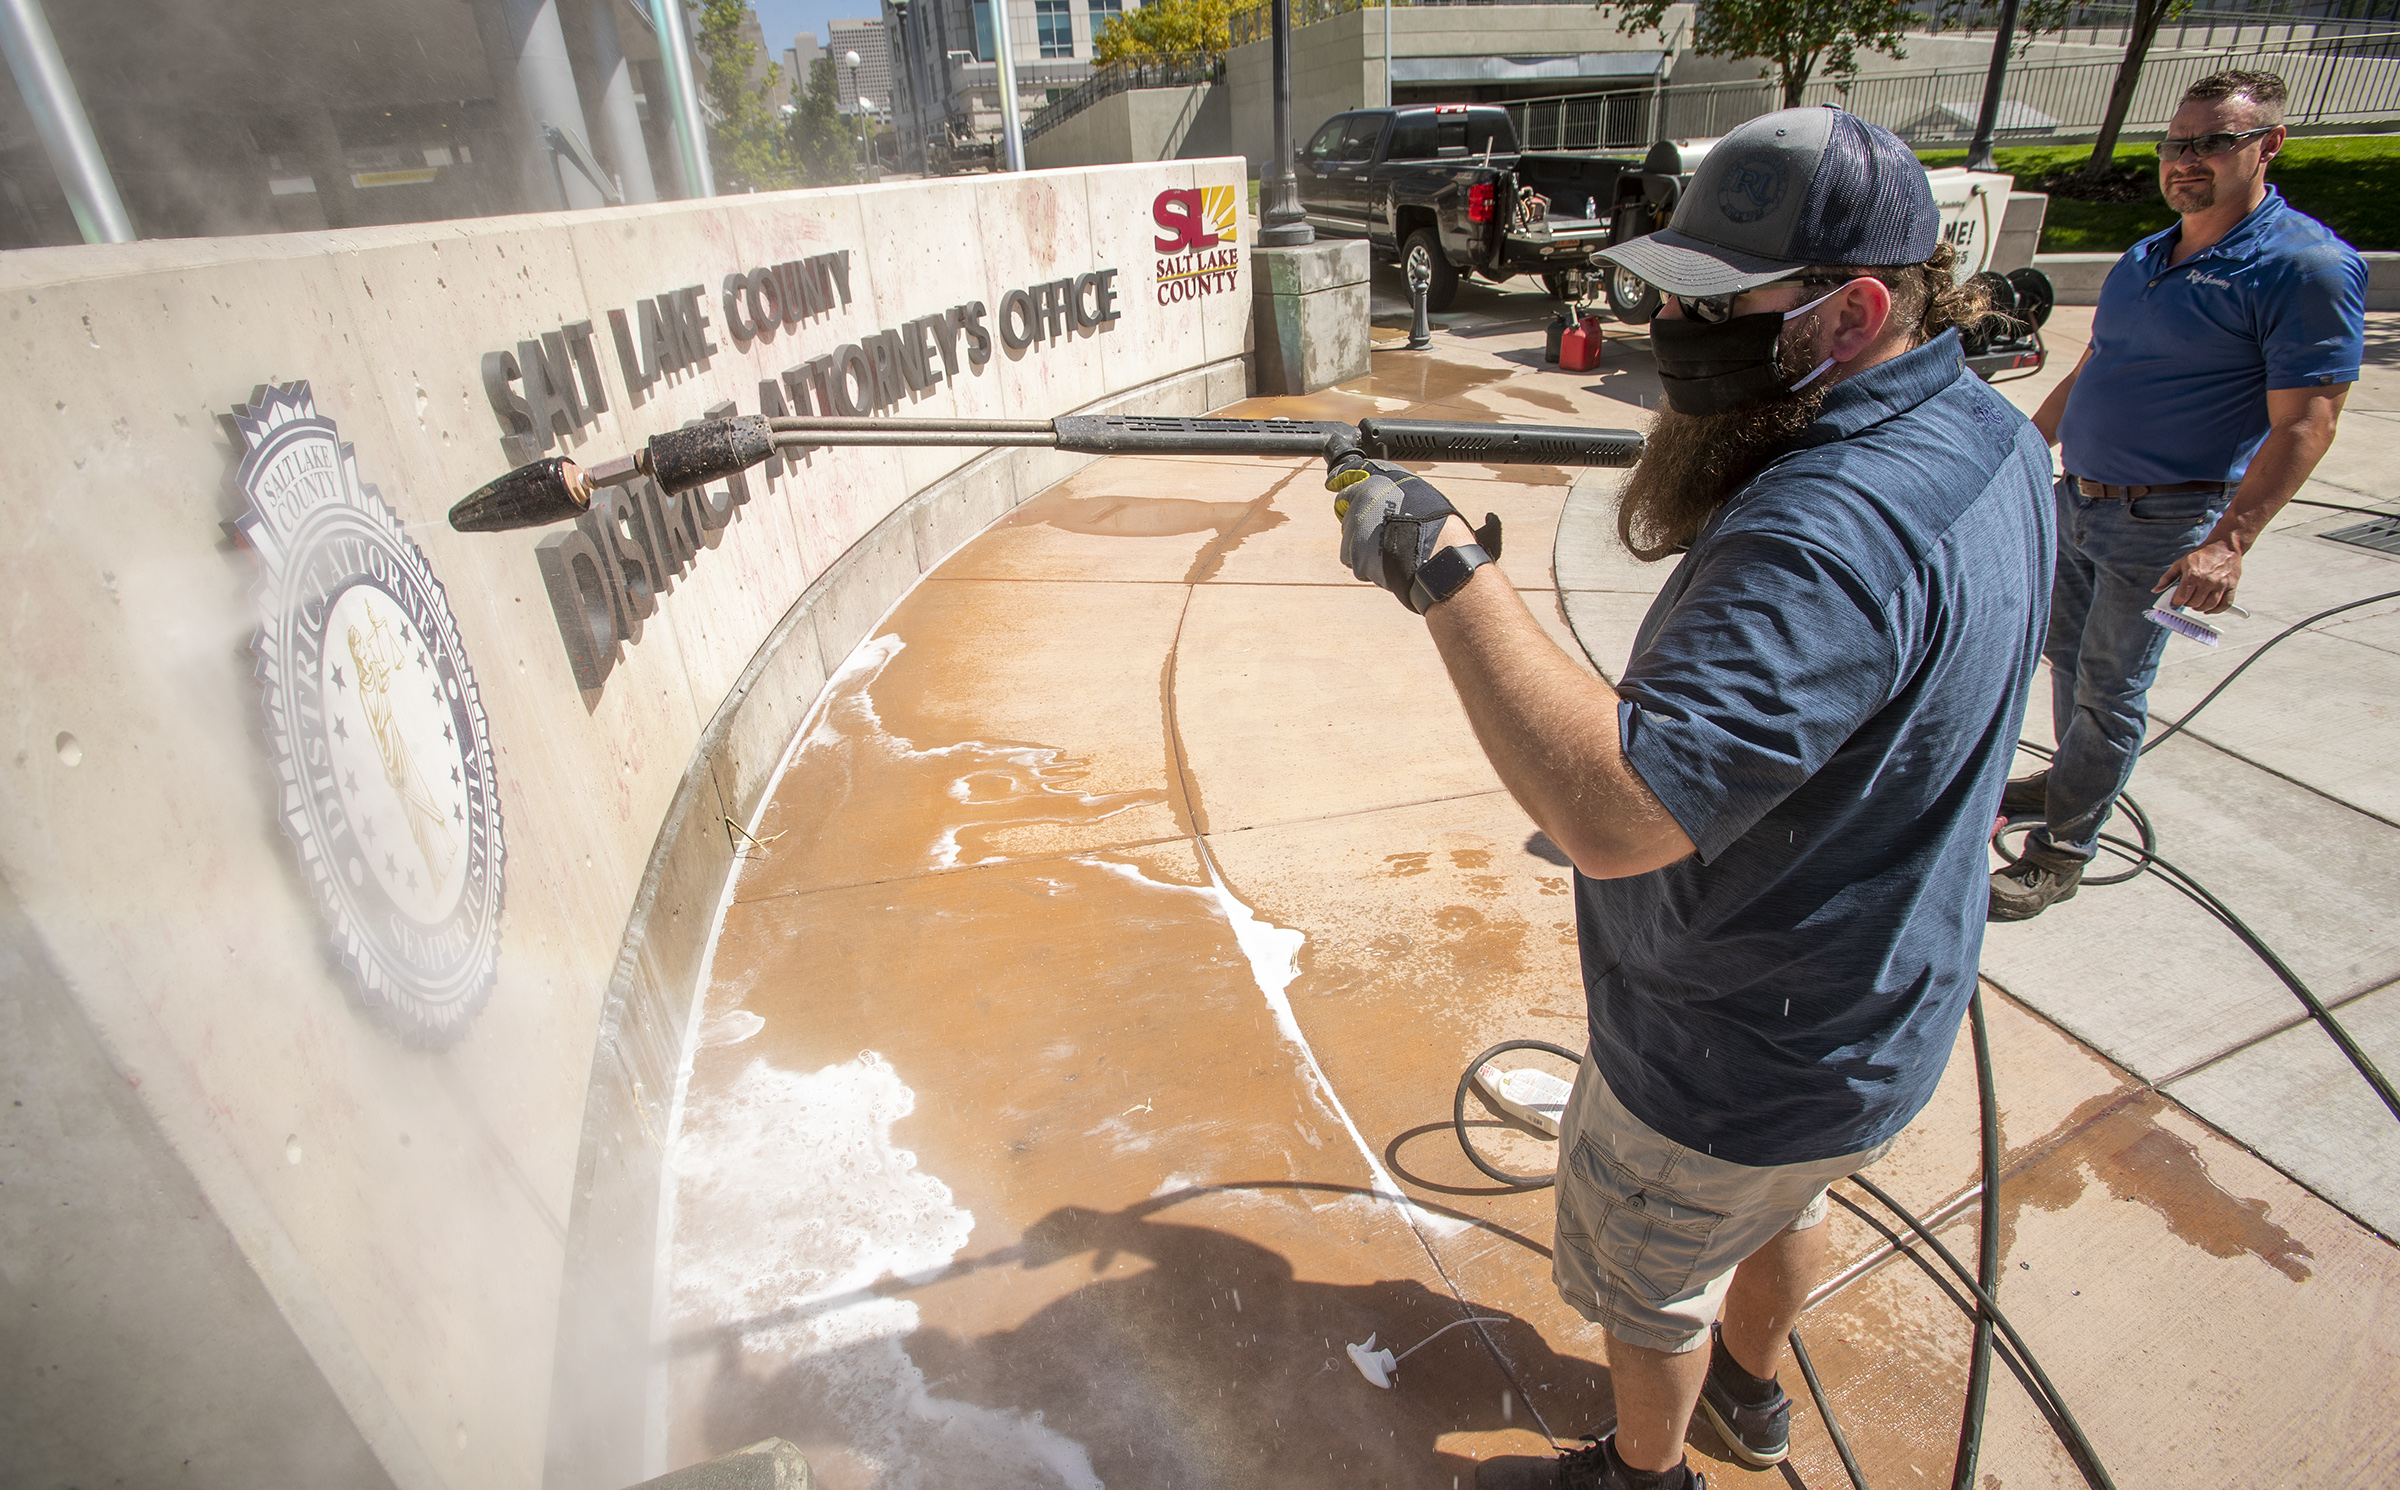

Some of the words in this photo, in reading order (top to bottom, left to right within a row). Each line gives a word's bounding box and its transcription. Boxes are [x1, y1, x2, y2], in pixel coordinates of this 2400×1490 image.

[1152, 187, 1219, 253] SL
[1156, 253, 1194, 278] SALT
[1196, 248, 1239, 270] LAKE
[1156, 270, 1239, 306] COUNTY
[481, 350, 609, 469] SALT
[607, 283, 718, 394] LAKE
[722, 249, 852, 342] COUNTY
[758, 299, 992, 479] ATTORNEY'S
[999, 268, 1122, 350] OFFICE
[263, 455, 296, 508] SALT
[292, 445, 333, 475] LAKE
[277, 470, 338, 534] COUNTY
[296, 560, 350, 847] DISTRICT
[325, 536, 449, 667] ATTORNEY
[390, 913, 471, 972] SEMPER
